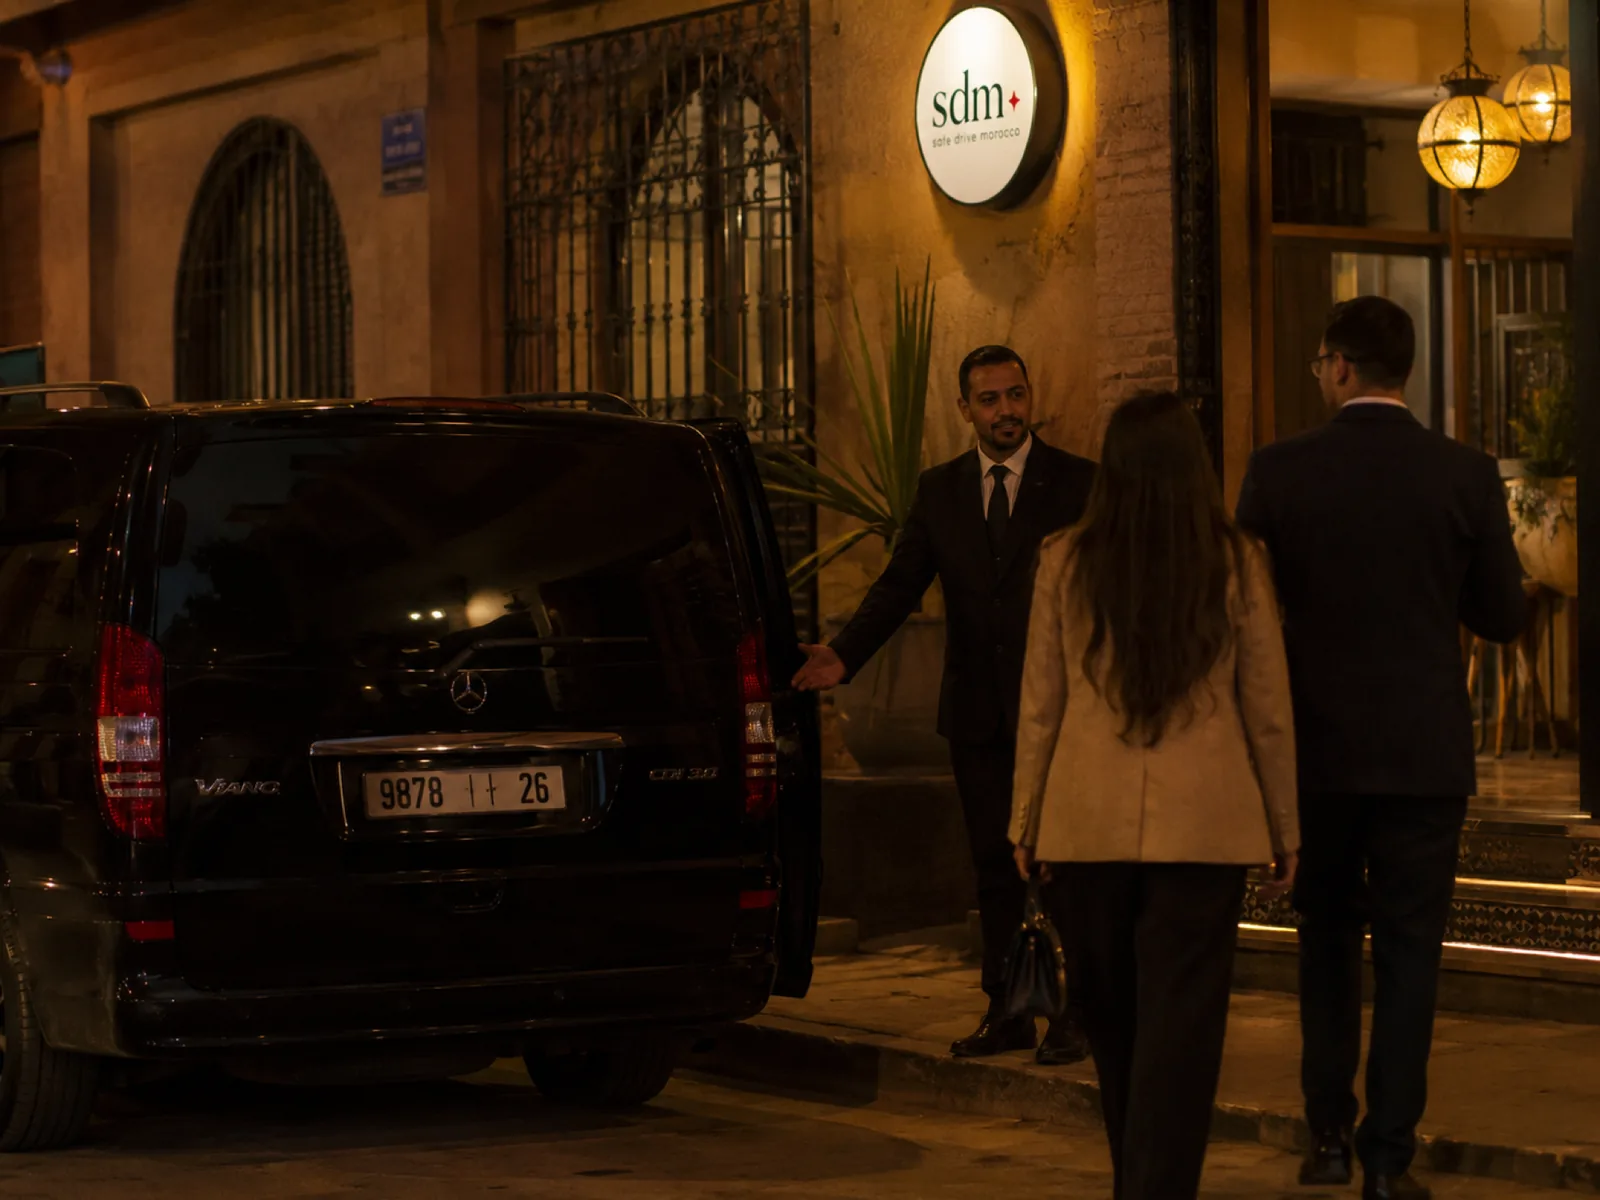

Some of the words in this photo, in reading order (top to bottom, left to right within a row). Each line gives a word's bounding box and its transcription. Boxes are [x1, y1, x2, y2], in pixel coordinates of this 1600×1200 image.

[932, 69, 1004, 128] sdm
[932, 134, 951, 148] safe
[954, 132, 977, 145] drive
[980, 127, 1021, 141] morocco
[379, 776, 444, 810] 9878
[519, 772, 550, 805] 26
